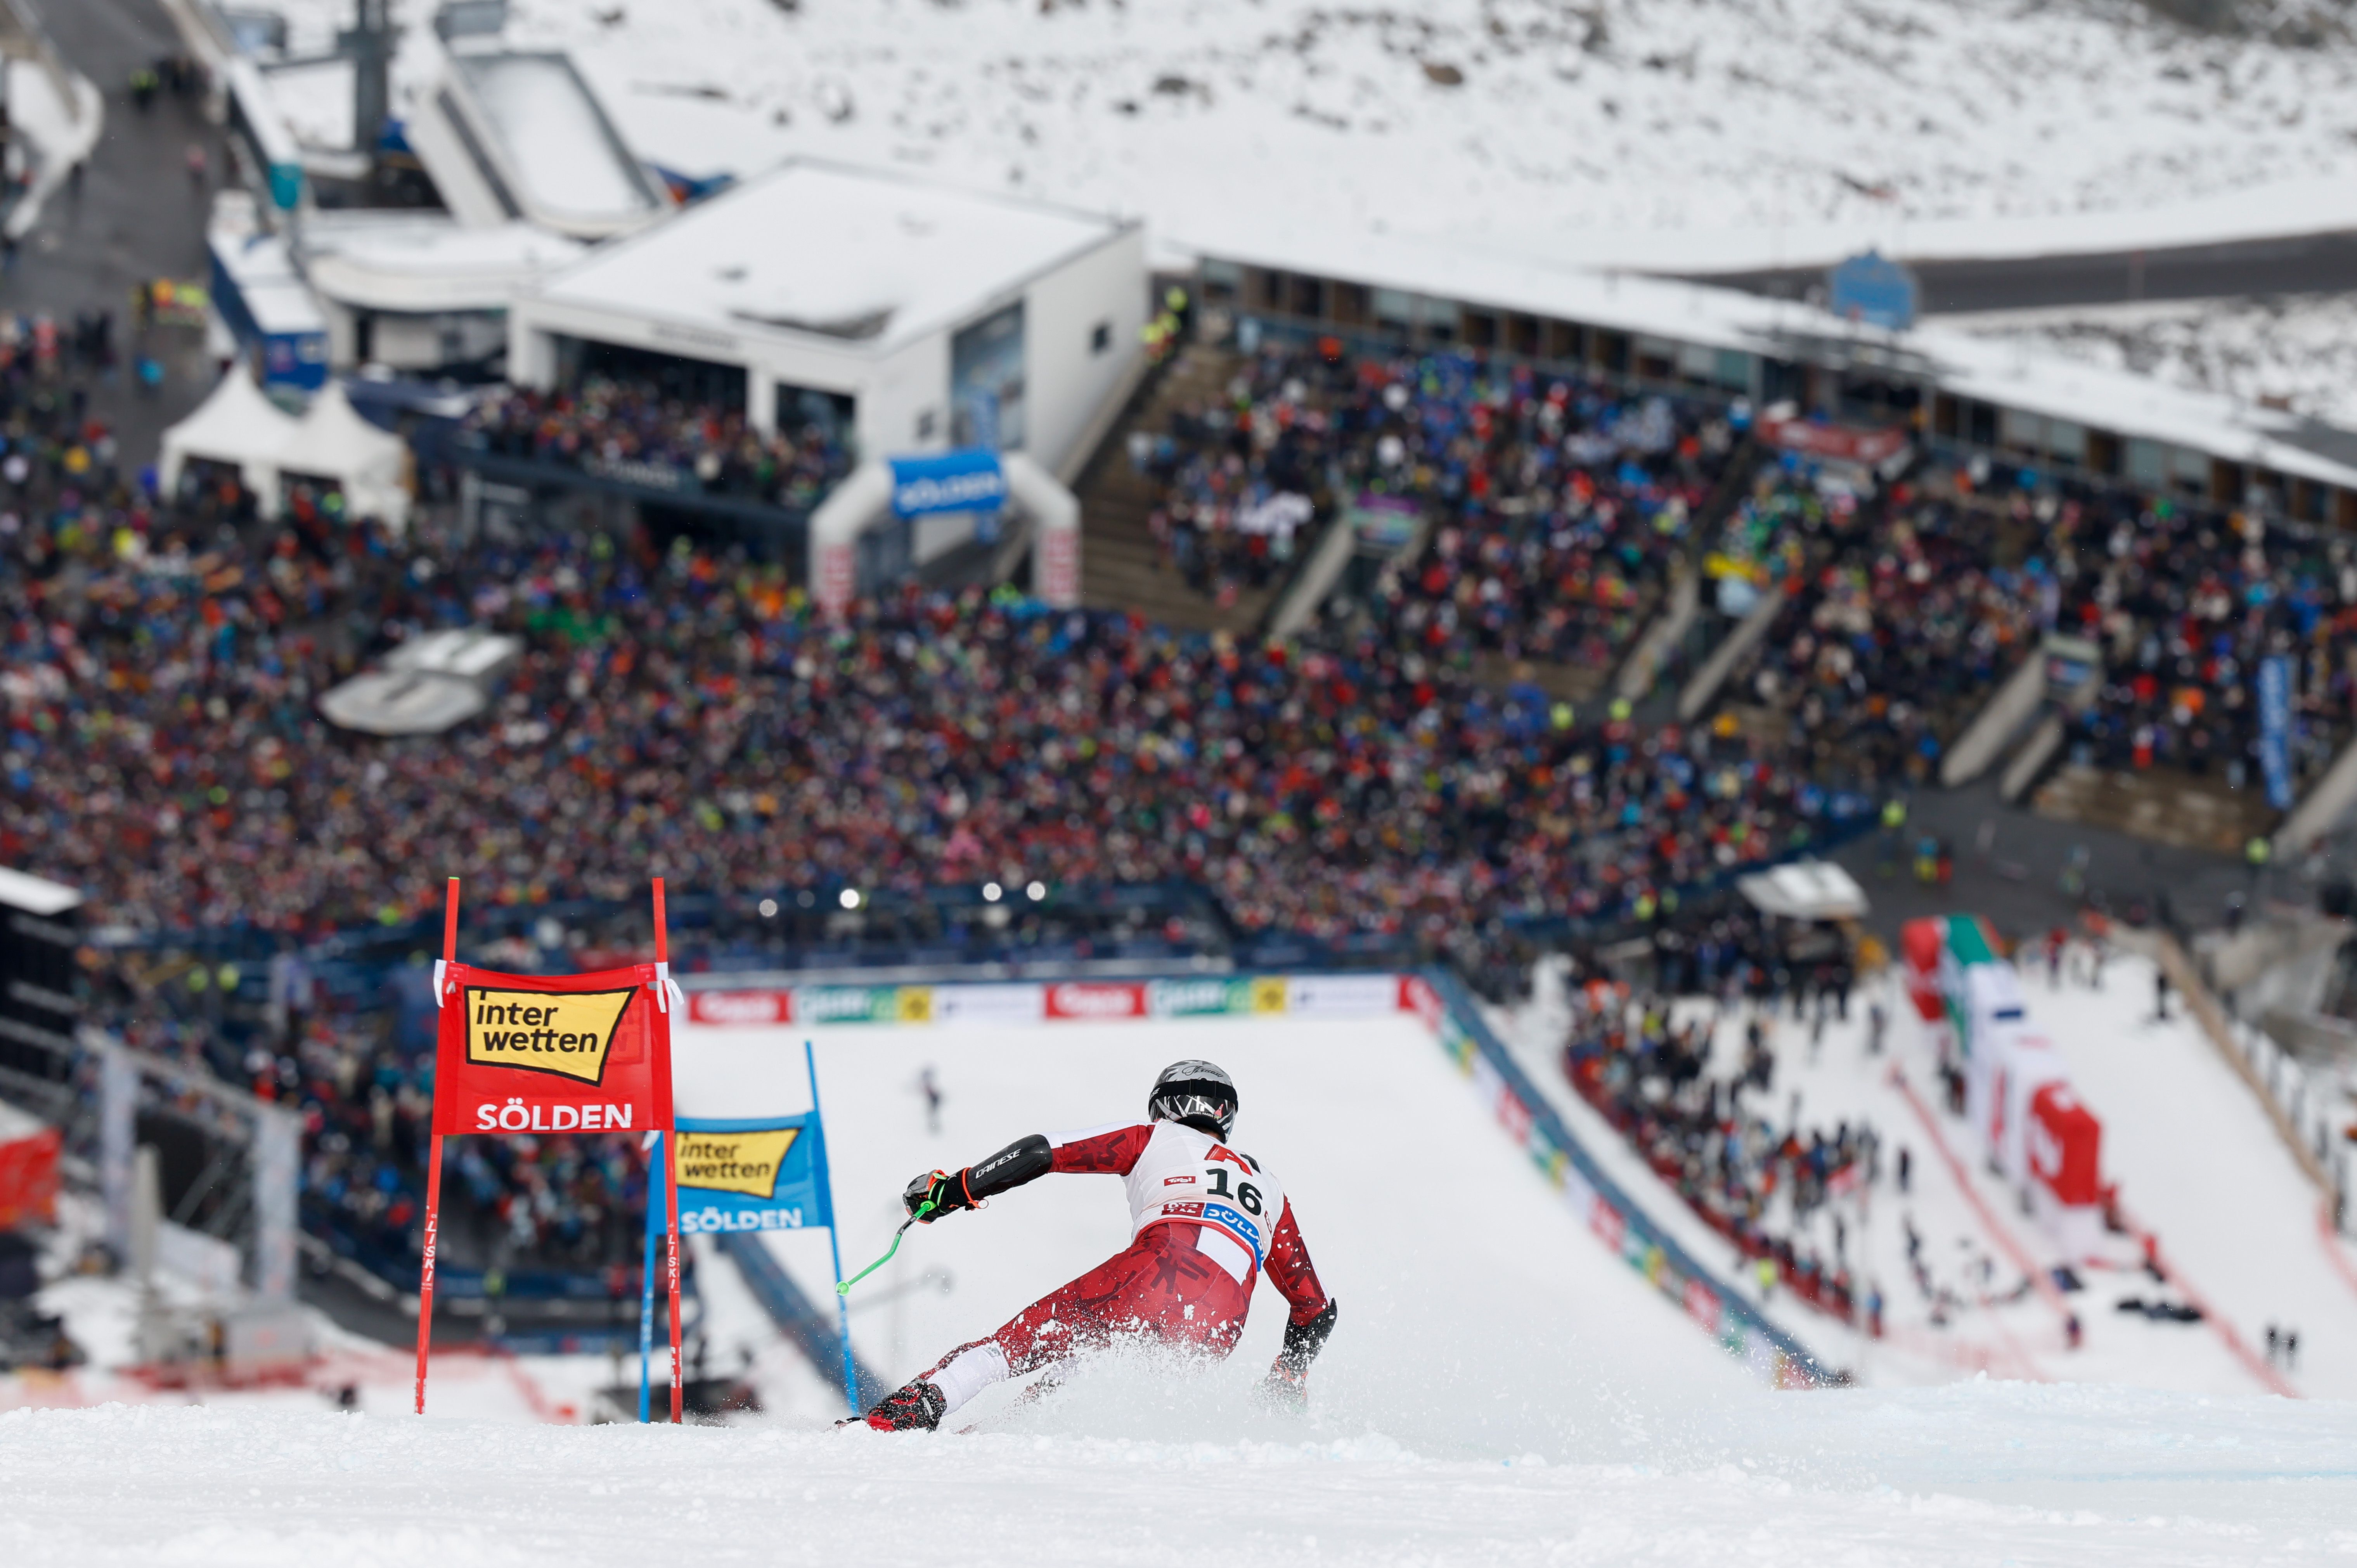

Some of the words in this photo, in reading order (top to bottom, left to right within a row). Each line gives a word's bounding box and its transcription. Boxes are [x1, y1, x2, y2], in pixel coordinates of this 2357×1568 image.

[476, 992, 559, 1026] inter
[483, 1029, 598, 1053] wetten
[476, 1097, 632, 1130] SÖLDEN
[681, 1134, 740, 1158] inter
[684, 1162, 770, 1179] wetten
[975, 1148, 1022, 1179] DAINESE
[1205, 1168, 1263, 1216] 16
[681, 1206, 803, 1232] SÖLDEN
[424, 1220, 437, 1282] LISKI
[668, 1234, 677, 1289] LISKI
